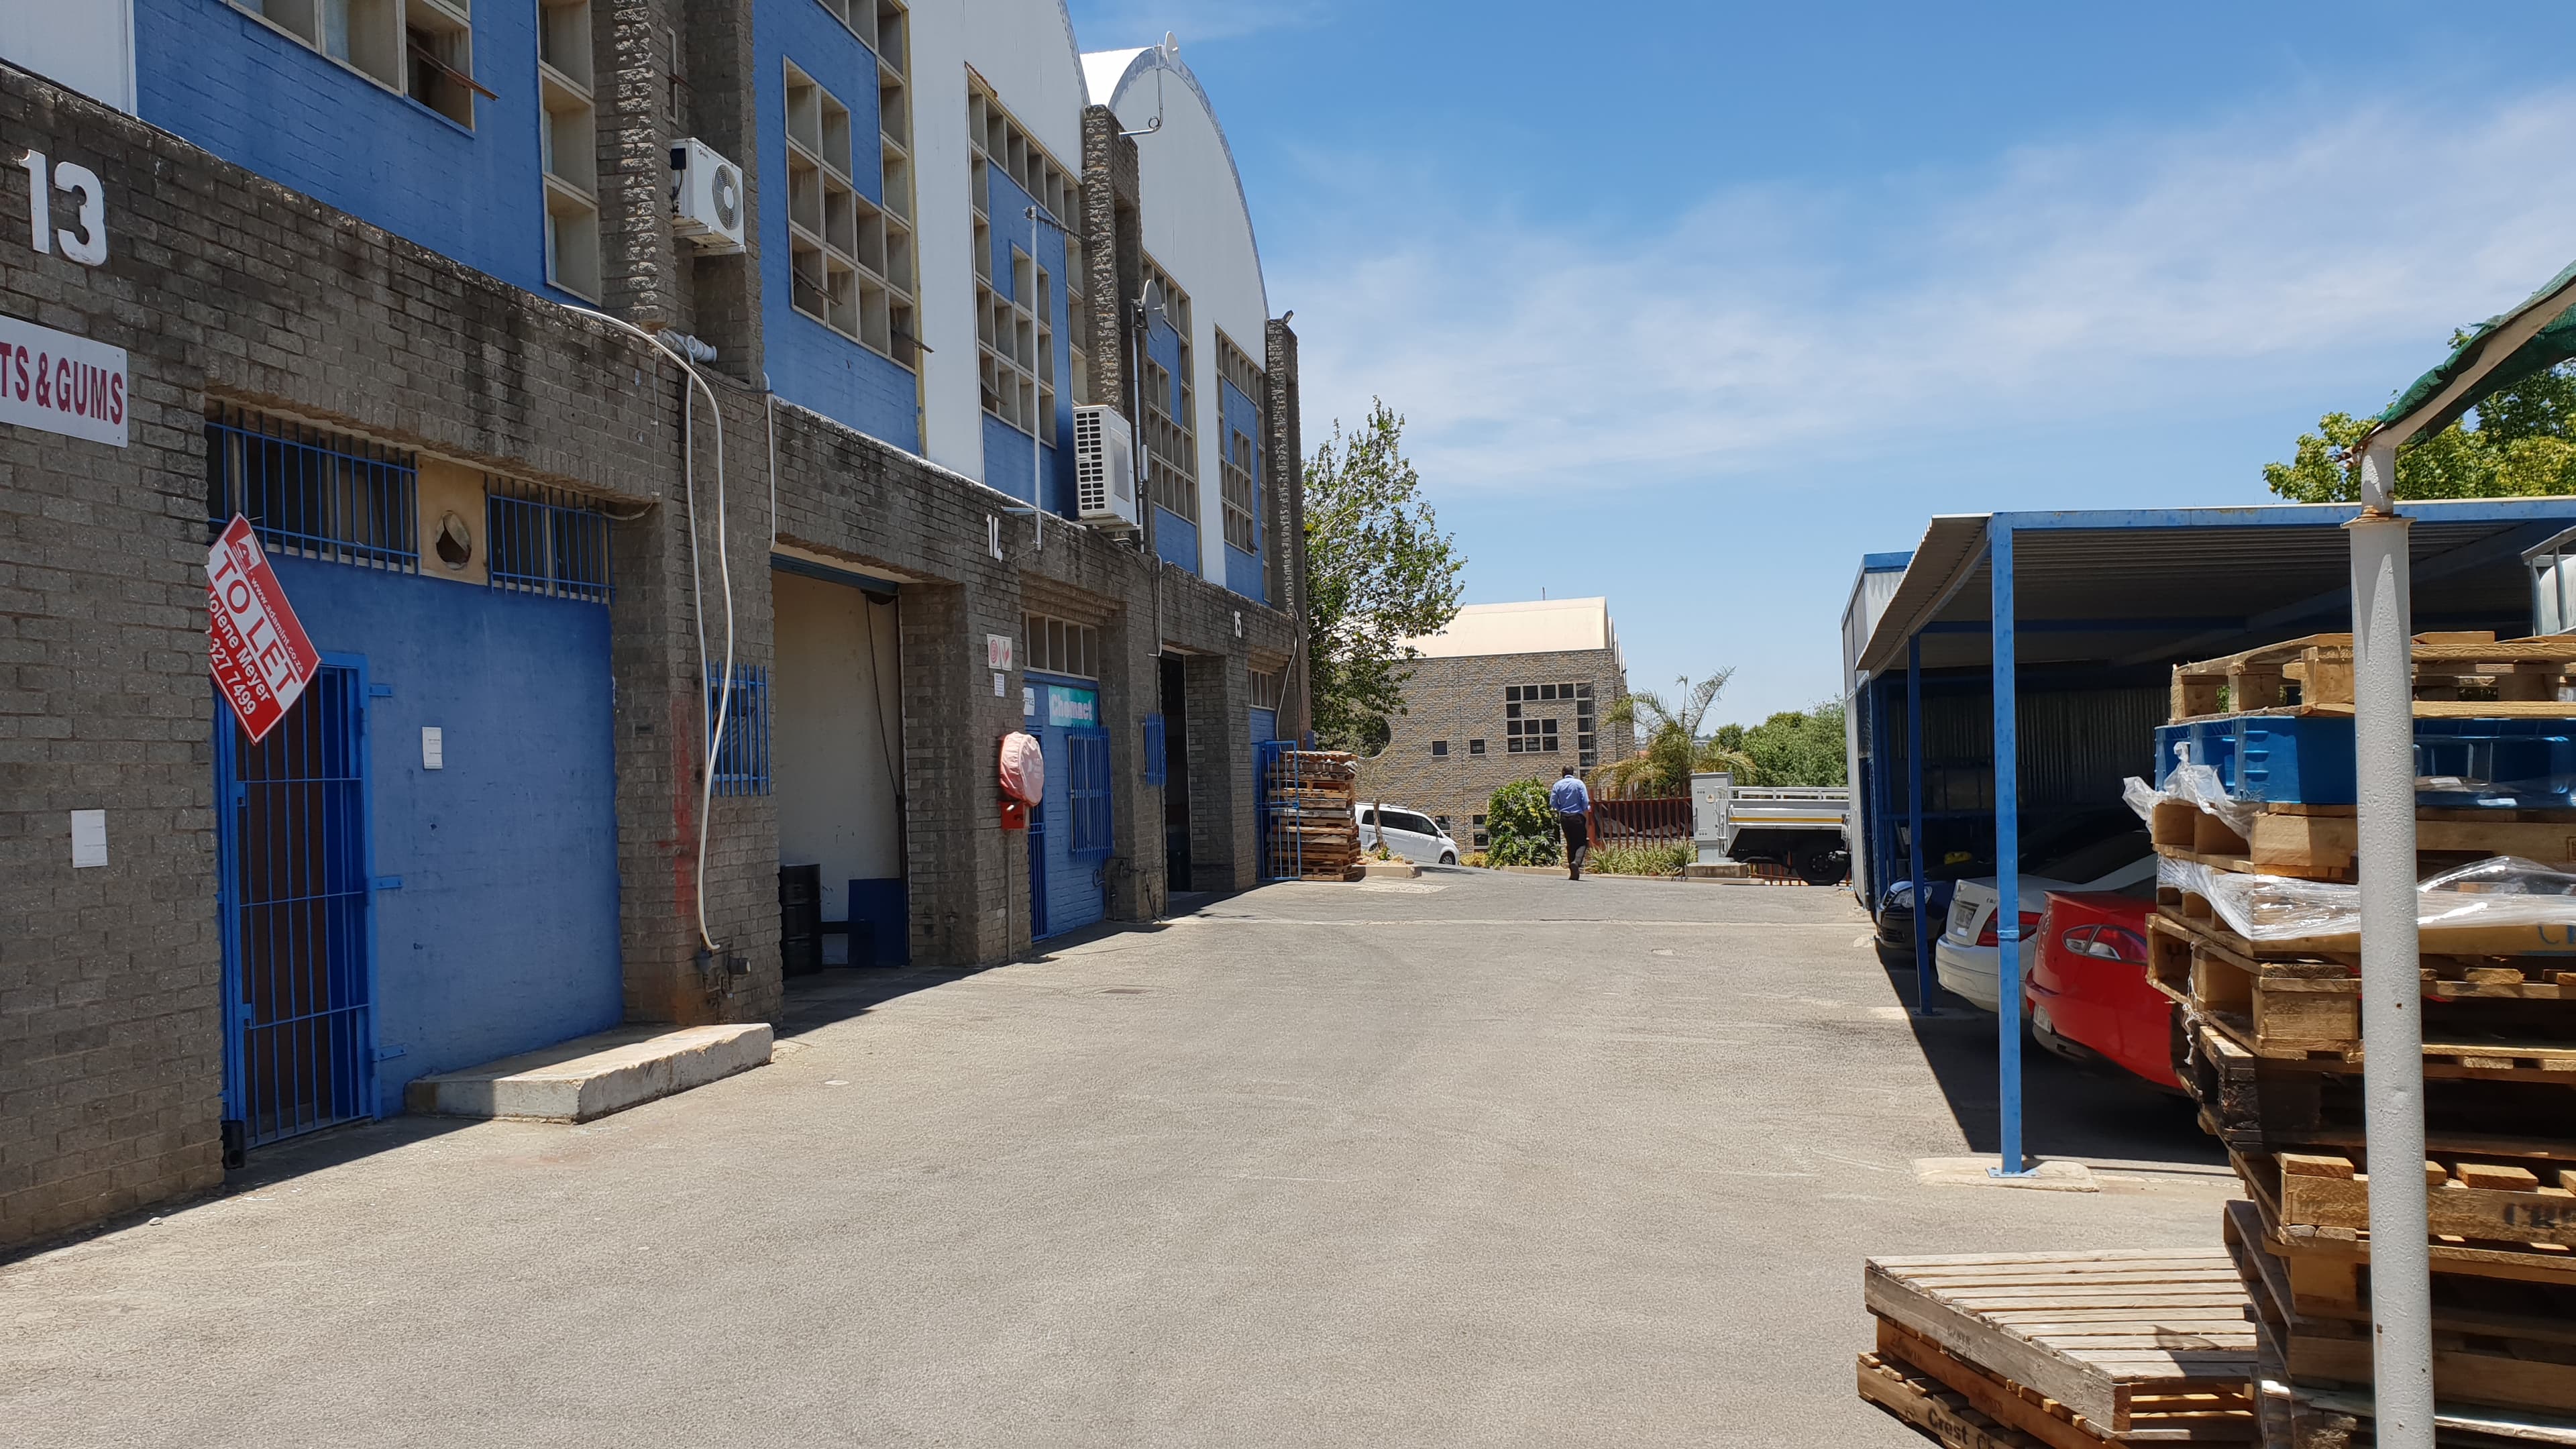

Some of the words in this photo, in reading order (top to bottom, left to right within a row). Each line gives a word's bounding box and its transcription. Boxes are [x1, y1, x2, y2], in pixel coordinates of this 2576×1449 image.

[18, 149, 107, 266] 13
[36, 352, 52, 408] &
[56, 358, 123, 425] GUMS
[215, 549, 251, 614] TO
[246, 616, 298, 692] LET
[1234, 610, 1242, 638] 15
[209, 638, 233, 670] 327
[226, 670, 256, 715] 7499
[235, 647, 271, 702] Meyer
[1928, 1407, 1968, 1445] Crest
